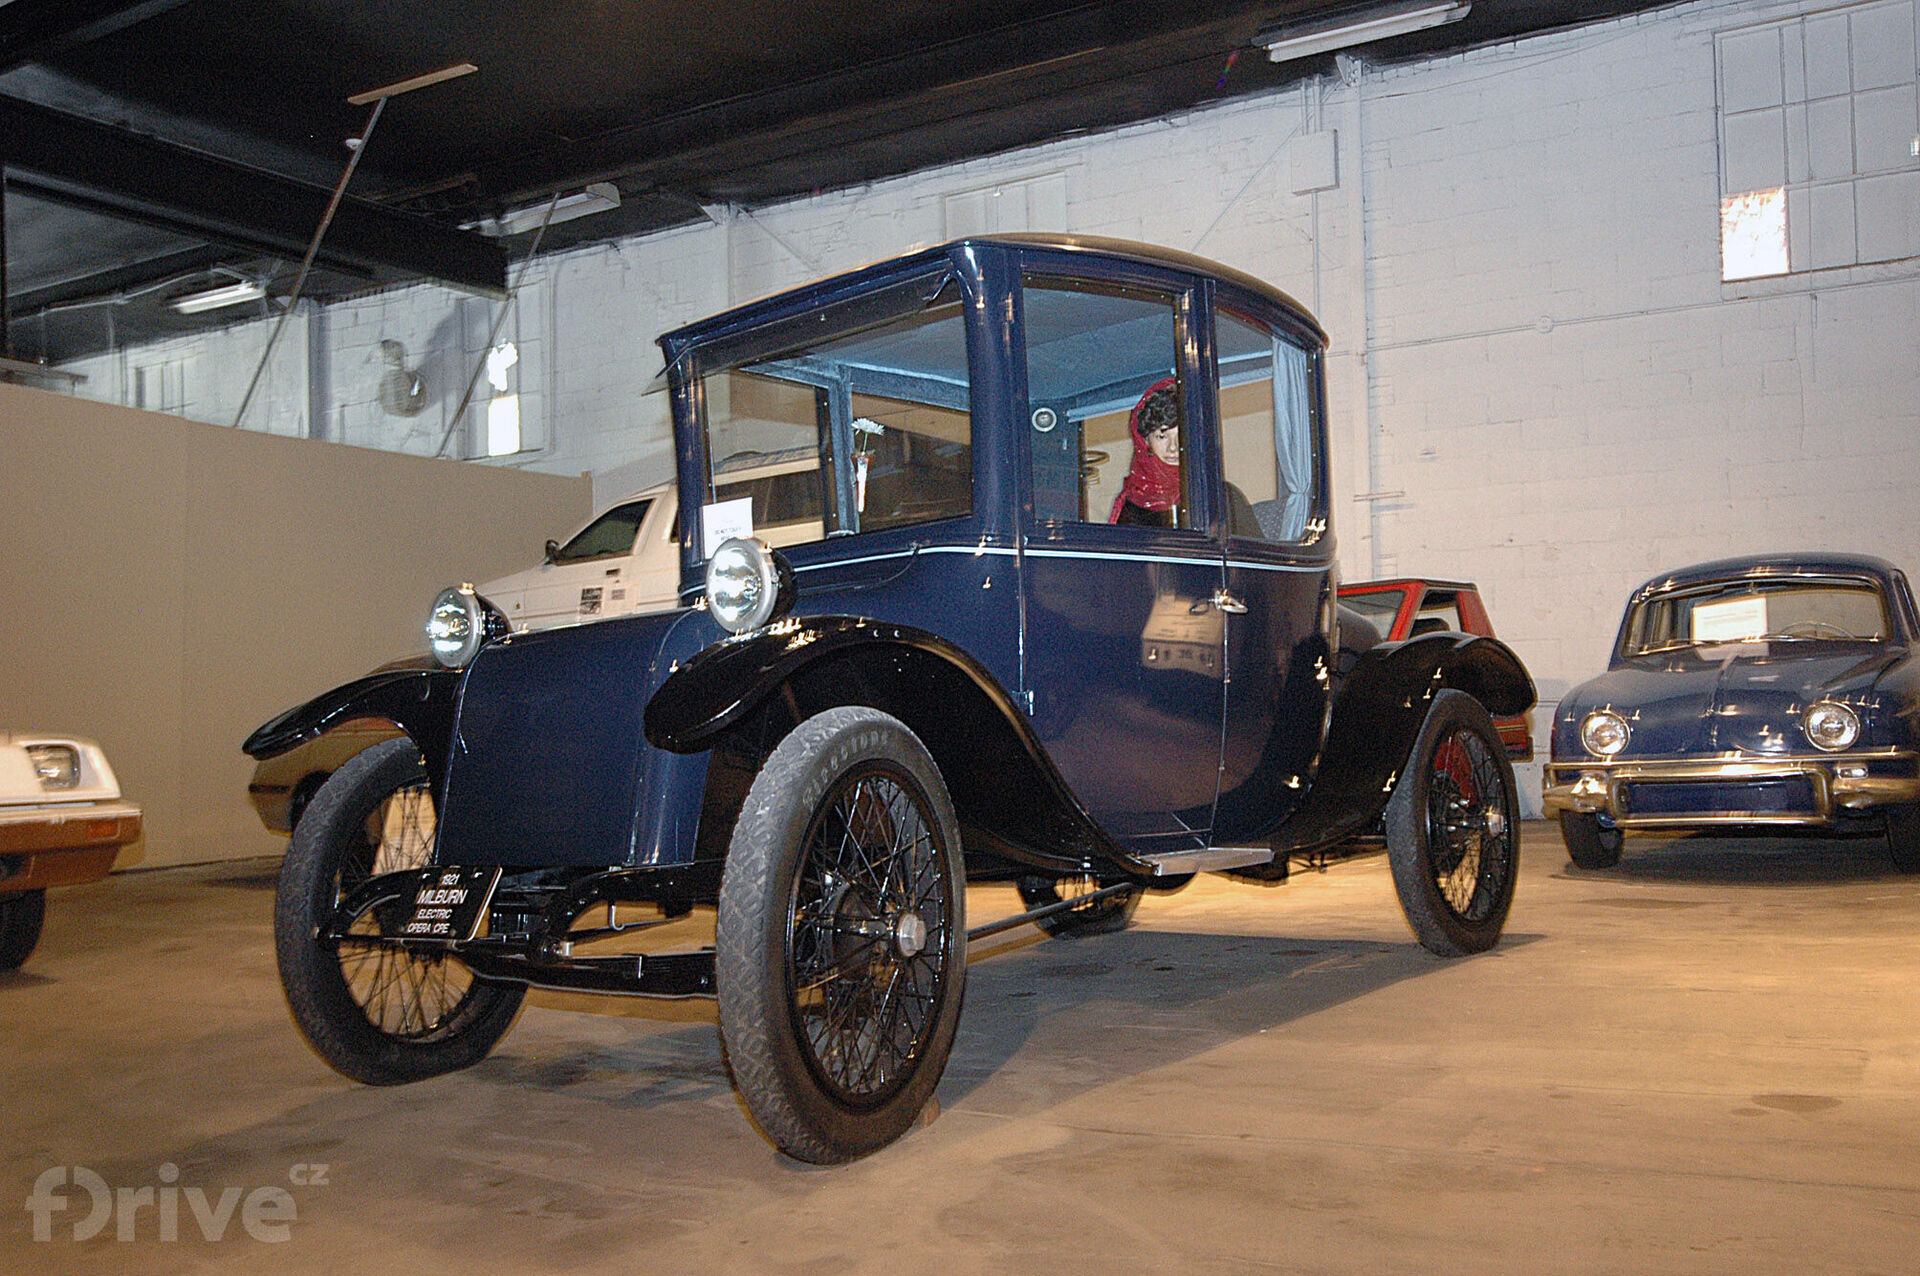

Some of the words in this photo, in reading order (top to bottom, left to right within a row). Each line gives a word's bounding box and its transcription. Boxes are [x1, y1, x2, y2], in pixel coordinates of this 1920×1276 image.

[441, 873, 460, 885] 1921
[416, 889, 468, 905] MILBURN
[417, 908, 453, 919] ELECTRIC
[407, 922, 432, 934] OPERA
[432, 922, 451, 934] CPE
